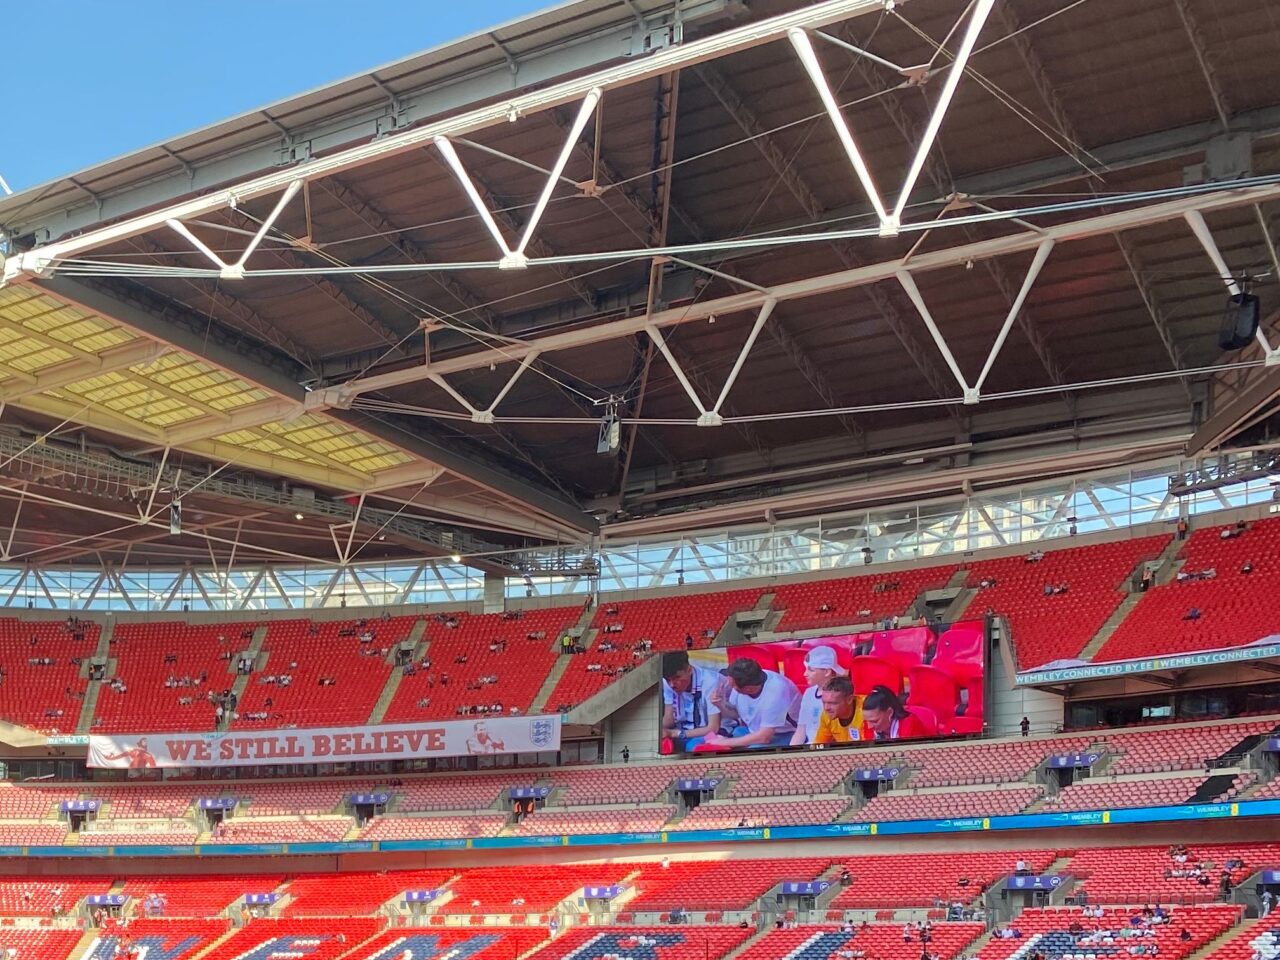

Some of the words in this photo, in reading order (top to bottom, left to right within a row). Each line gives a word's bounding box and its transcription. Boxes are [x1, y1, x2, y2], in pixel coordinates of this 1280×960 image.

[1160, 654, 1210, 667] WEMBLEY
[1212, 647, 1277, 662] CONNECTED
[1015, 672, 1062, 684] WEMBLEY
[1064, 665, 1122, 679] CONNECTED
[1125, 663, 1138, 672] BY
[1140, 661, 1152, 670] EE
[165, 739, 211, 761] WE
[219, 736, 305, 761] STILL
[312, 728, 446, 757] BELIEVE
[1196, 804, 1230, 813] WEMBLEY
[1070, 812, 1101, 821] WEMBLEY
[952, 819, 982, 827] WEMBLEY
[736, 828, 763, 836] WEMBLEY
[842, 824, 870, 832] WEMBLEY
